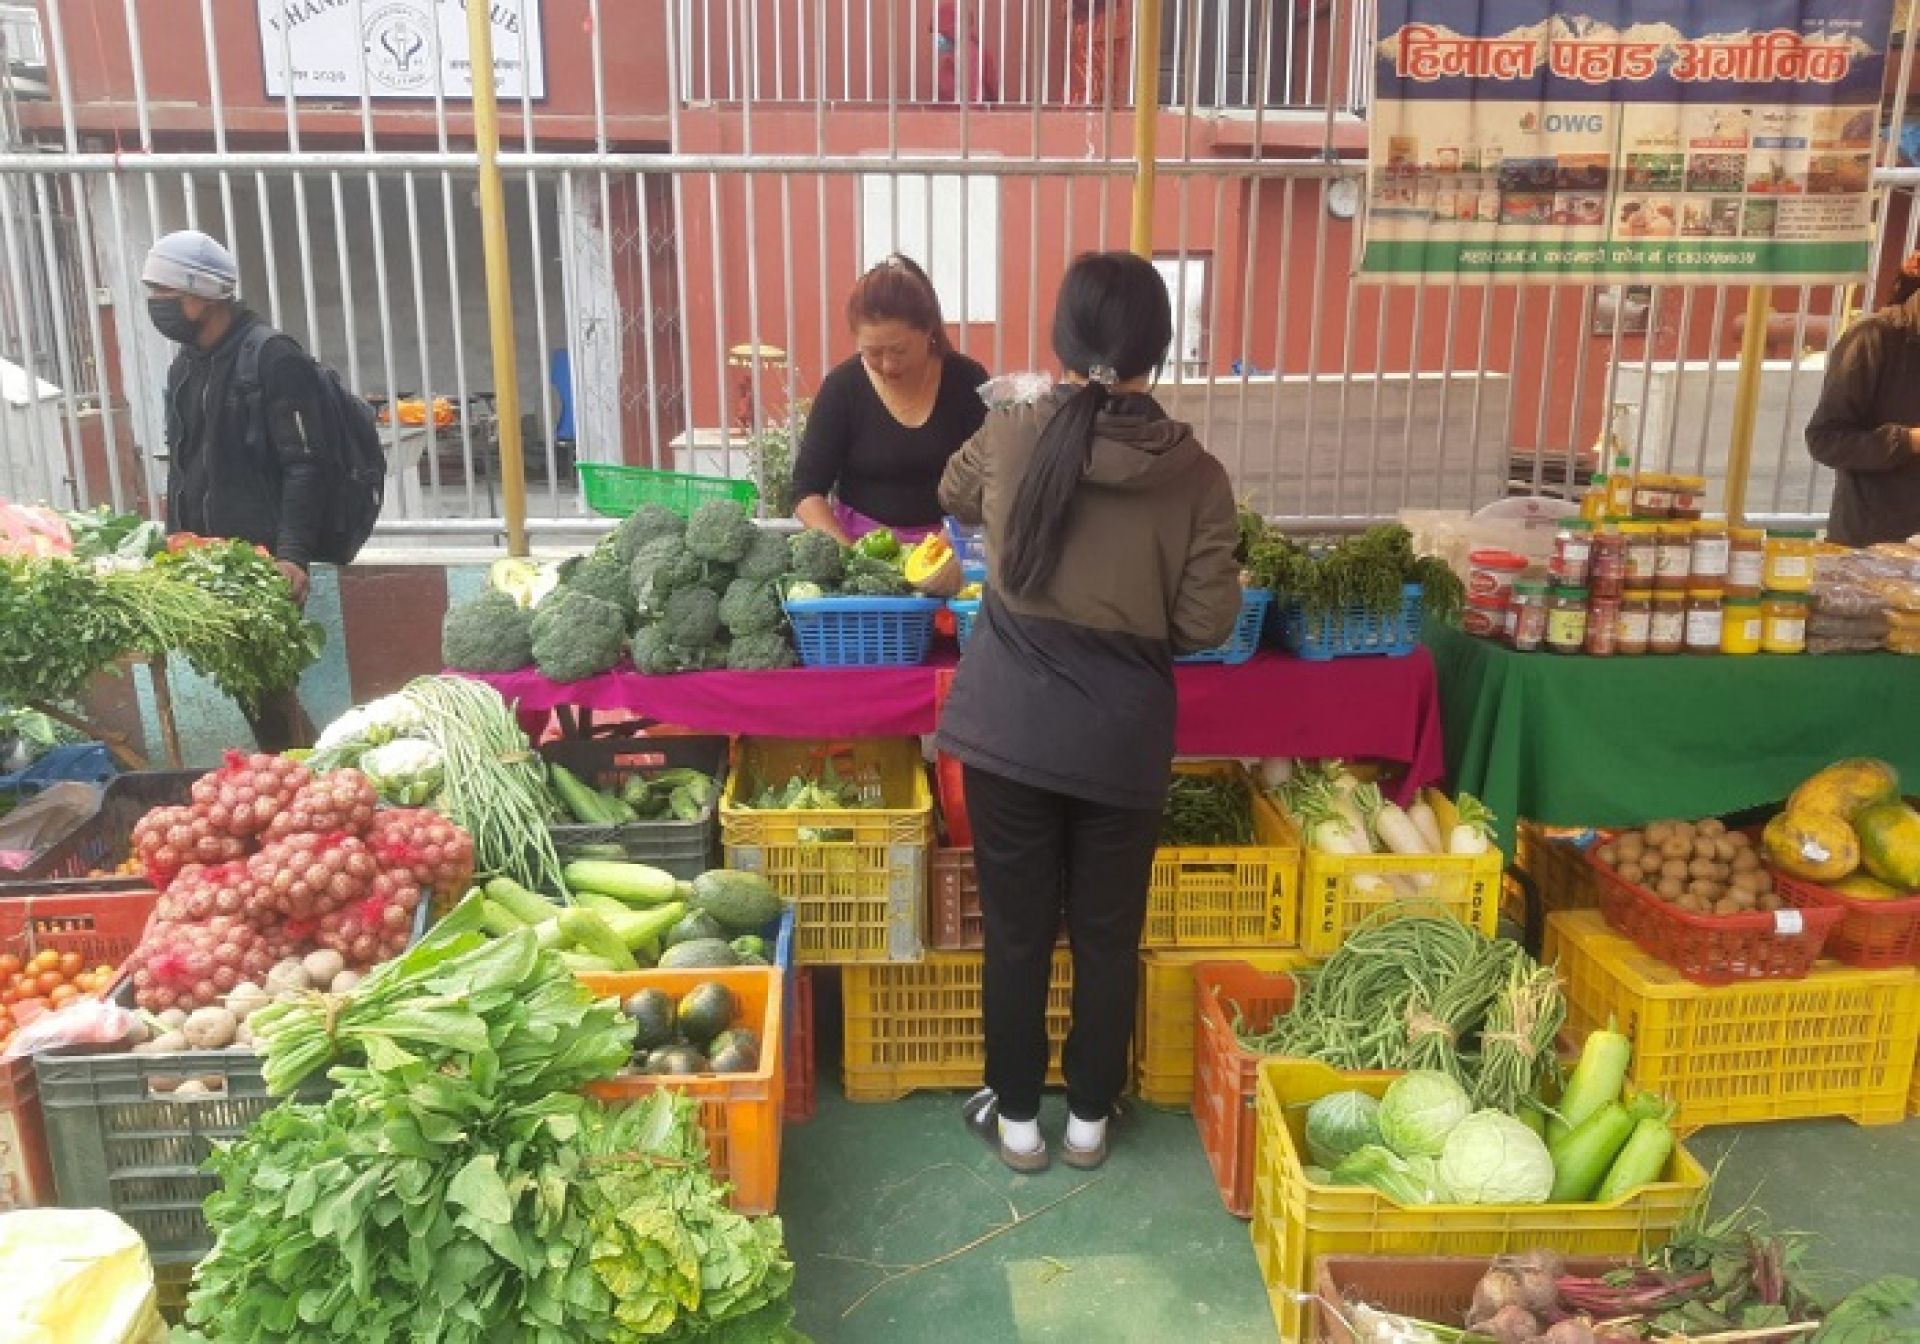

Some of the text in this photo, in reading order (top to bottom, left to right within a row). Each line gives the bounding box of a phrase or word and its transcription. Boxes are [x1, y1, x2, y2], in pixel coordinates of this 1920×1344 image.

[1397, 22, 1537, 81] हिमाल
[1551, 39, 1662, 81] पहाड
[1544, 114, 1603, 133] OWG
